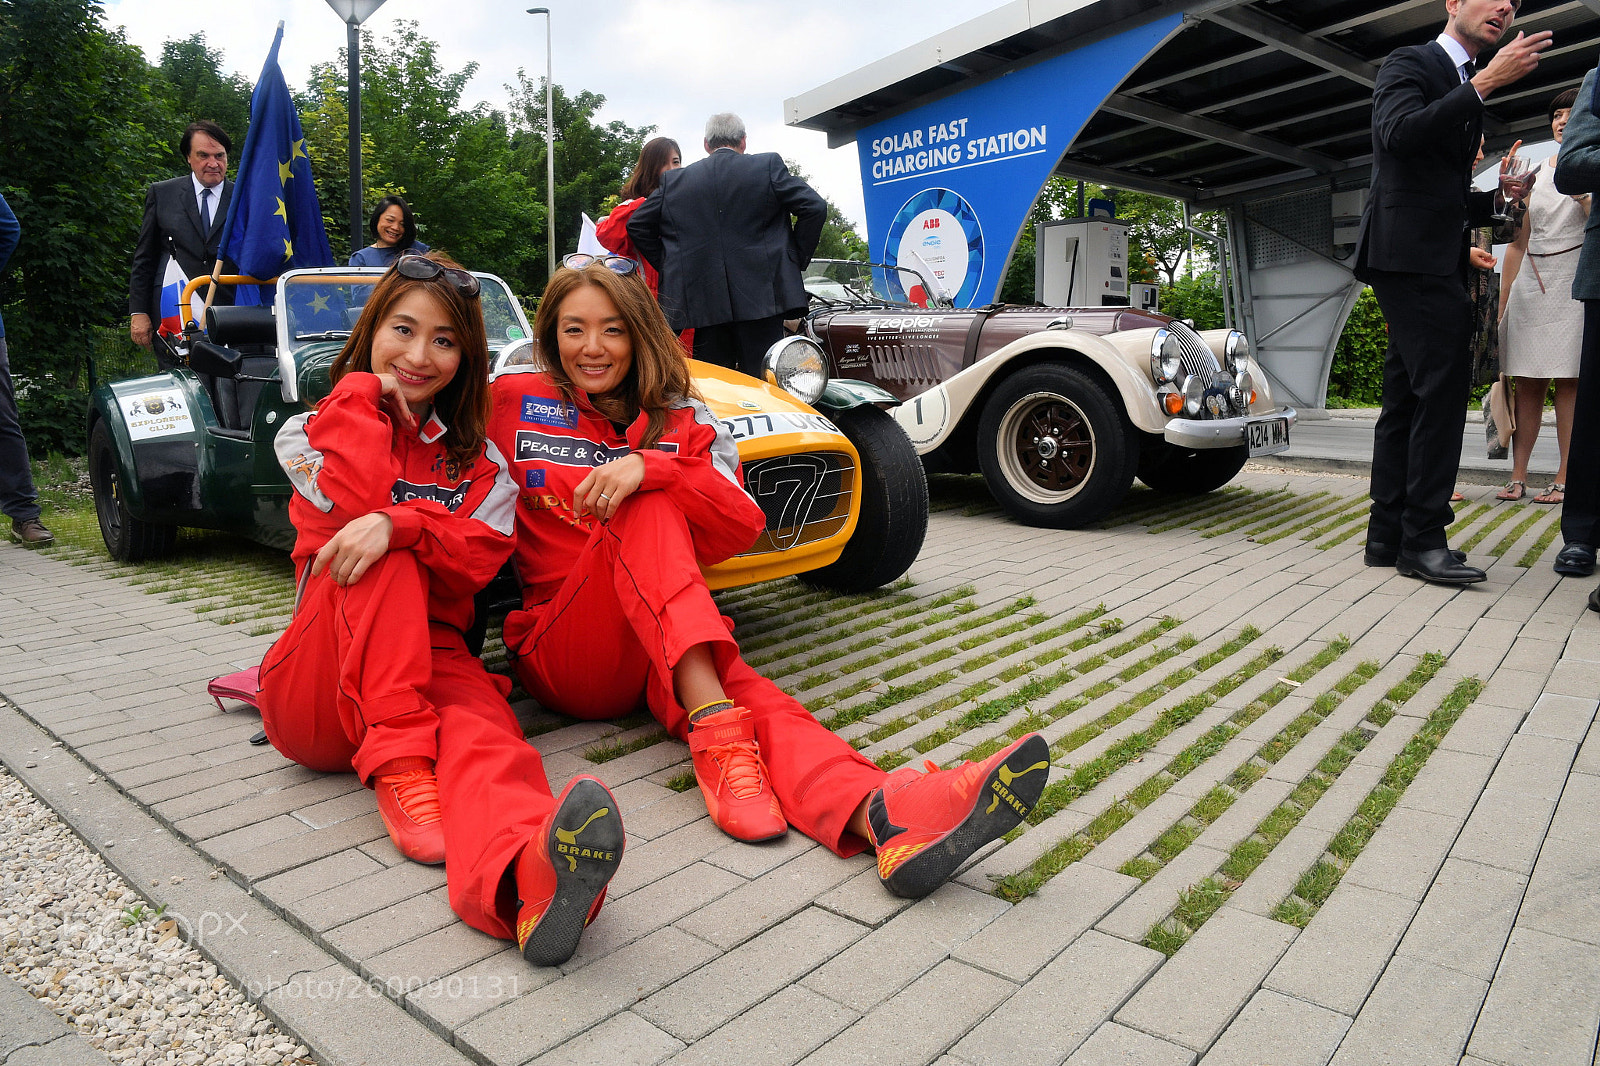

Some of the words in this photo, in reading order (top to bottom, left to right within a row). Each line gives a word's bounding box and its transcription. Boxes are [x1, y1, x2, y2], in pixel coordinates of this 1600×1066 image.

[872, 129, 923, 158] SOLAR
[928, 117, 969, 145] FAST
[872, 144, 962, 179] CHARGING
[967, 125, 1047, 160] STATION
[923, 218, 940, 230] ABB
[866, 315, 945, 334] zepter
[525, 402, 575, 418] zepter
[914, 397, 924, 425] 1
[130, 414, 189, 428] EXPLORERS
[148, 424, 176, 432] CLUB
[1250, 425, 1269, 449] A214
[520, 439, 570, 457] PEACE
[575, 447, 588, 459] &
[714, 726, 743, 740] PUMA
[991, 779, 1029, 816] BRAKE
[557, 843, 615, 861] BRAKE
